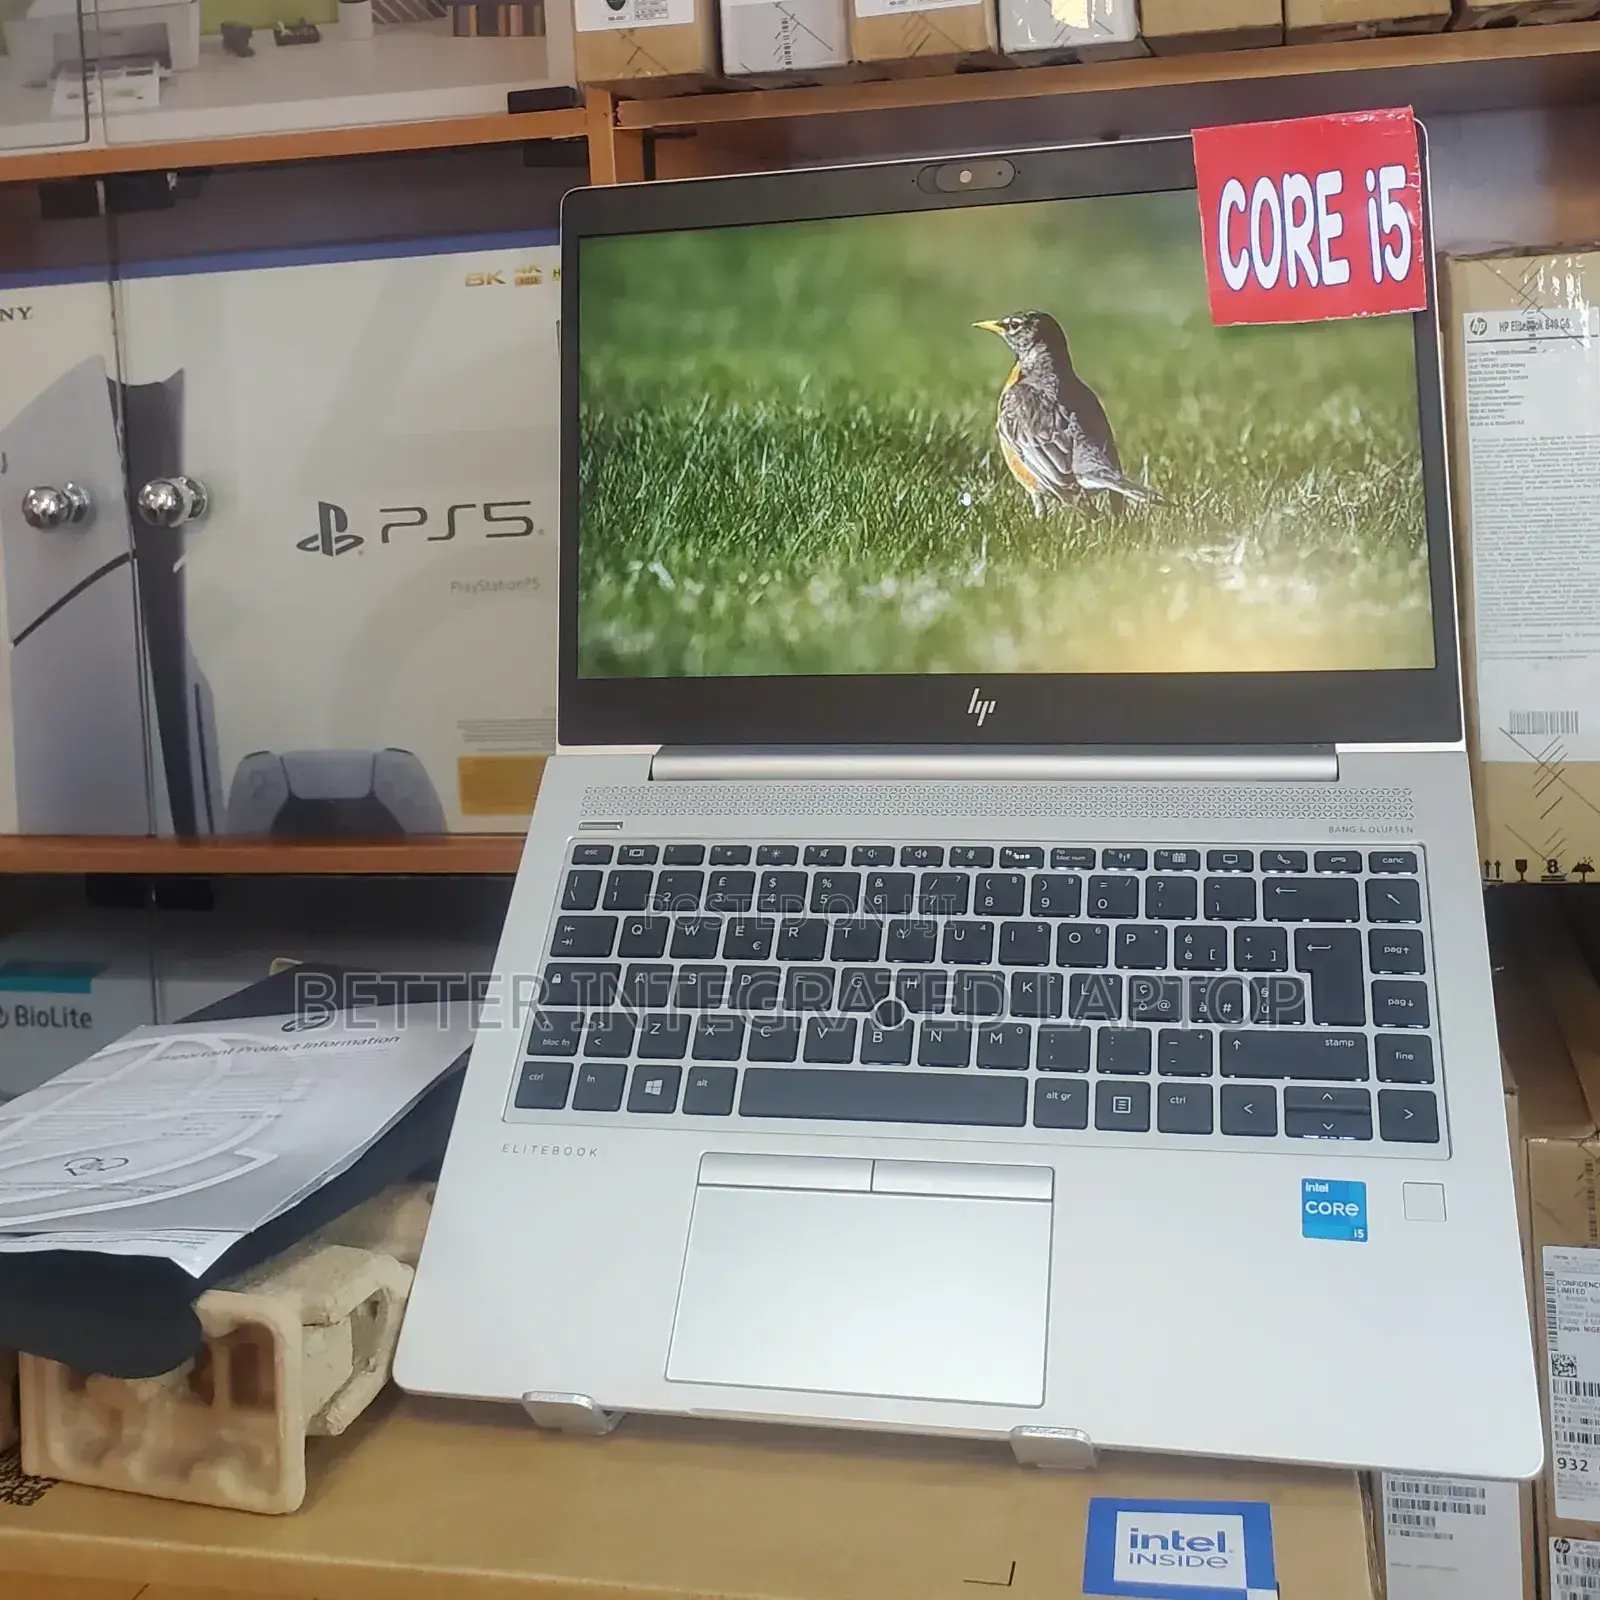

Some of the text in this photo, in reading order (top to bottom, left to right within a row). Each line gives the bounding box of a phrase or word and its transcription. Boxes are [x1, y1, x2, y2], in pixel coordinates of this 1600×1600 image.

[1218, 164, 1412, 291] CORE i5
[0, 306, 32, 322] NY
[1499, 321, 1509, 333] HP
[379, 501, 534, 544] PS5
[1328, 826, 1357, 834] BANG
[1368, 826, 1414, 834] OLUFSEN
[718, 876, 728, 887] £
[768, 877, 778, 888] $
[822, 878, 833, 889] %
[874, 877, 884, 888] &
[1011, 876, 1018, 884] 8
[1067, 877, 1074, 885] 9
[1157, 881, 1165, 891] ?
[663, 892, 672, 902] 2
[715, 893, 724, 903] 3
[767, 893, 777, 903] 4
[820, 894, 829, 905] 5
[873, 894, 883, 905] 6
[929, 895, 937, 905] 7
[984, 896, 994, 907] 8
[1041, 897, 1050, 908] 9
[631, 924, 643, 936] Q
[683, 925, 700, 936] W
[734, 925, 745, 937] E
[787, 926, 799, 938] R
[841, 927, 851, 939] T
[1037, 924, 1044, 932] 5
[898, 928, 909, 940] Y
[954, 929, 965, 941] U
[1068, 932, 1081, 944] O
[1125, 933, 1137, 945] P
[1184, 932, 1193, 944] é
[751, 940, 762, 951] €
[1384, 946, 1403, 955] pag
[1184, 949, 1193, 961] è
[634, 973, 645, 984] A
[687, 974, 697, 985] S
[741, 974, 752, 986] D
[852, 976, 863, 988] G
[906, 978, 918, 989] H
[1108, 977, 1115, 986] 3
[963, 979, 972, 991] J
[1022, 981, 1033, 993] K
[1081, 983, 1090, 995] L
[1157, 999, 1172, 1011] @
[1198, 1002, 1208, 1013] à
[1222, 1002, 1232, 1013] #
[1387, 997, 1406, 1008] pag
[1261, 1003, 1270, 1014] ù
[14, 1004, 93, 1030] BioLite
[650, 1023, 662, 1035] Z
[704, 1025, 716, 1036] X
[760, 1026, 772, 1038] C
[816, 1027, 829, 1039] V
[872, 1031, 884, 1043] B
[930, 1030, 942, 1043] N
[989, 1032, 1003, 1045] M
[236, 1043, 300, 1055] Product
[302, 1034, 401, 1051] Information
[561, 1038, 571, 1047] fn
[1324, 1037, 1355, 1048] stamp
[1395, 1051, 1414, 1061] fine
[528, 1072, 544, 1081] ctrl
[586, 1074, 596, 1083] fn
[696, 1079, 709, 1087] alt
[1046, 1091, 1071, 1102] alt gr
[1169, 1095, 1186, 1105] ctrl
[502, 1143, 598, 1157] ELITEBOOK
[1353, 1228, 1365, 1239] i5
[1556, 1286, 1586, 1295] LIMITED
[1558, 1324, 1580, 1333] Lagos
[1557, 1457, 1590, 1473] 932
[1129, 1527, 1226, 1554] intel
